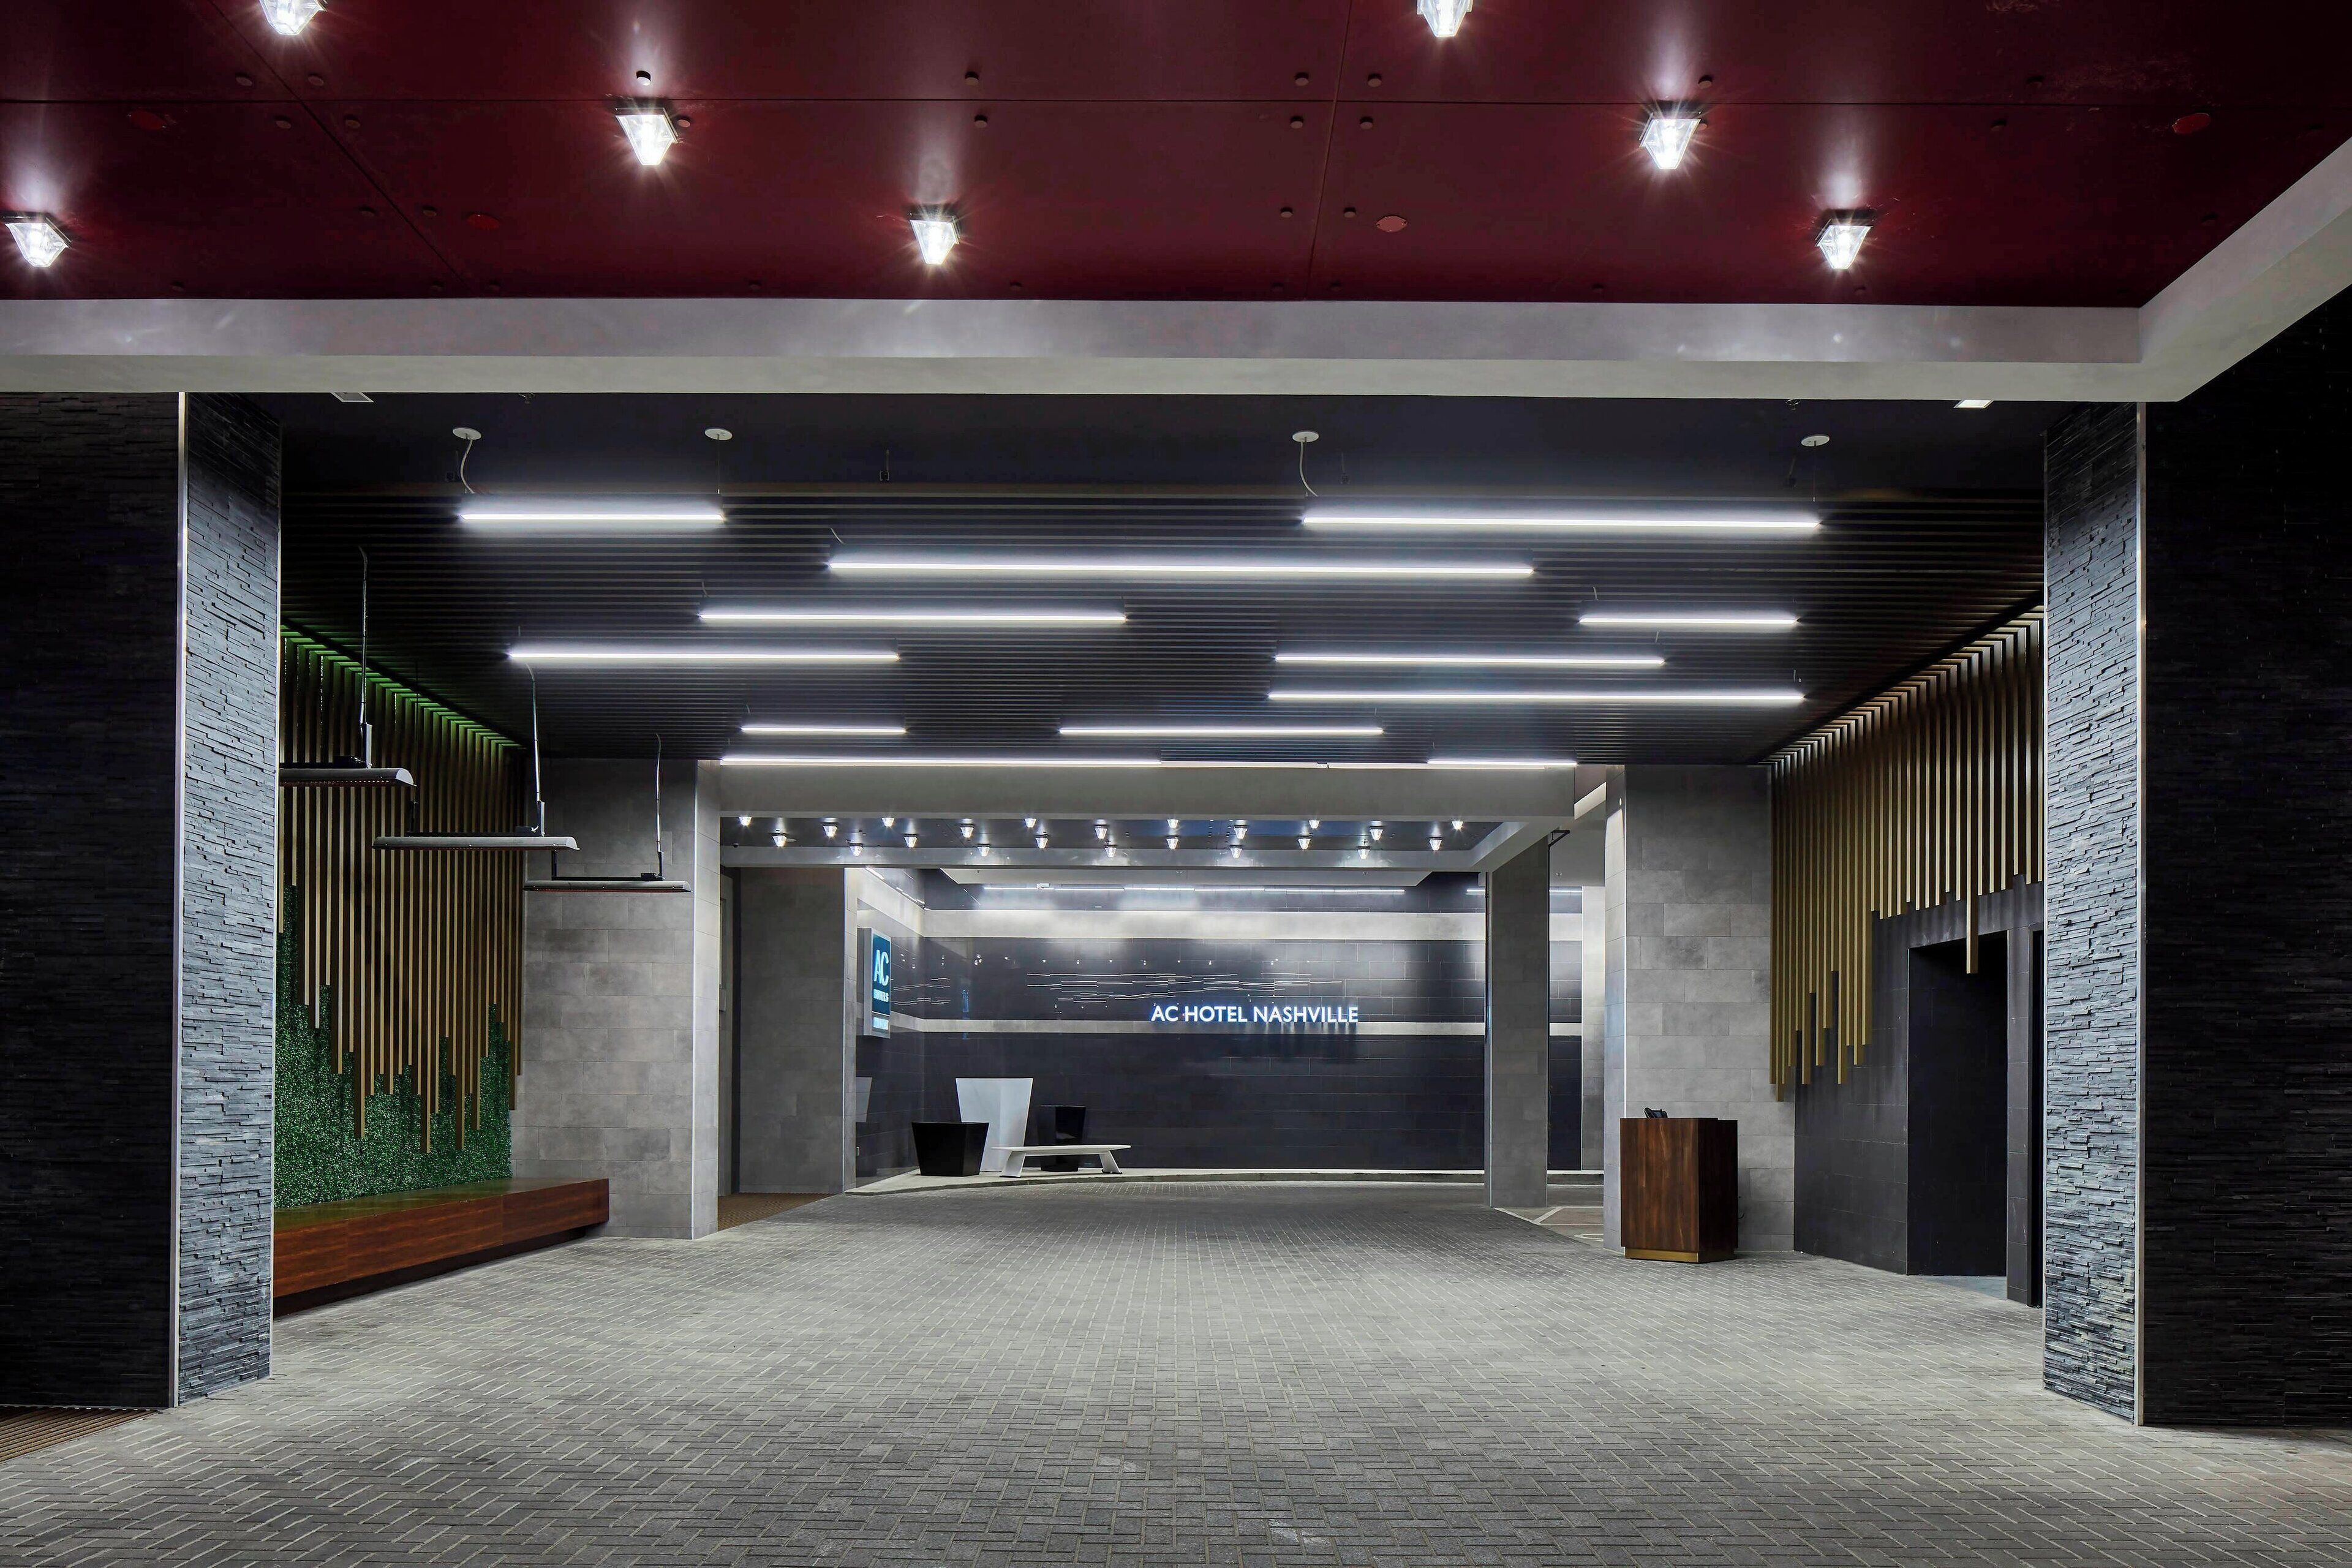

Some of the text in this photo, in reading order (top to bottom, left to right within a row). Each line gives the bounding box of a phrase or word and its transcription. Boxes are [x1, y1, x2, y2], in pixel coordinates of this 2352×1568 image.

[873, 949, 889, 986] AC
[873, 989, 889, 1002] HOTELS
[1151, 1006, 1359, 1023] AC HOTEL NASHVILLE
